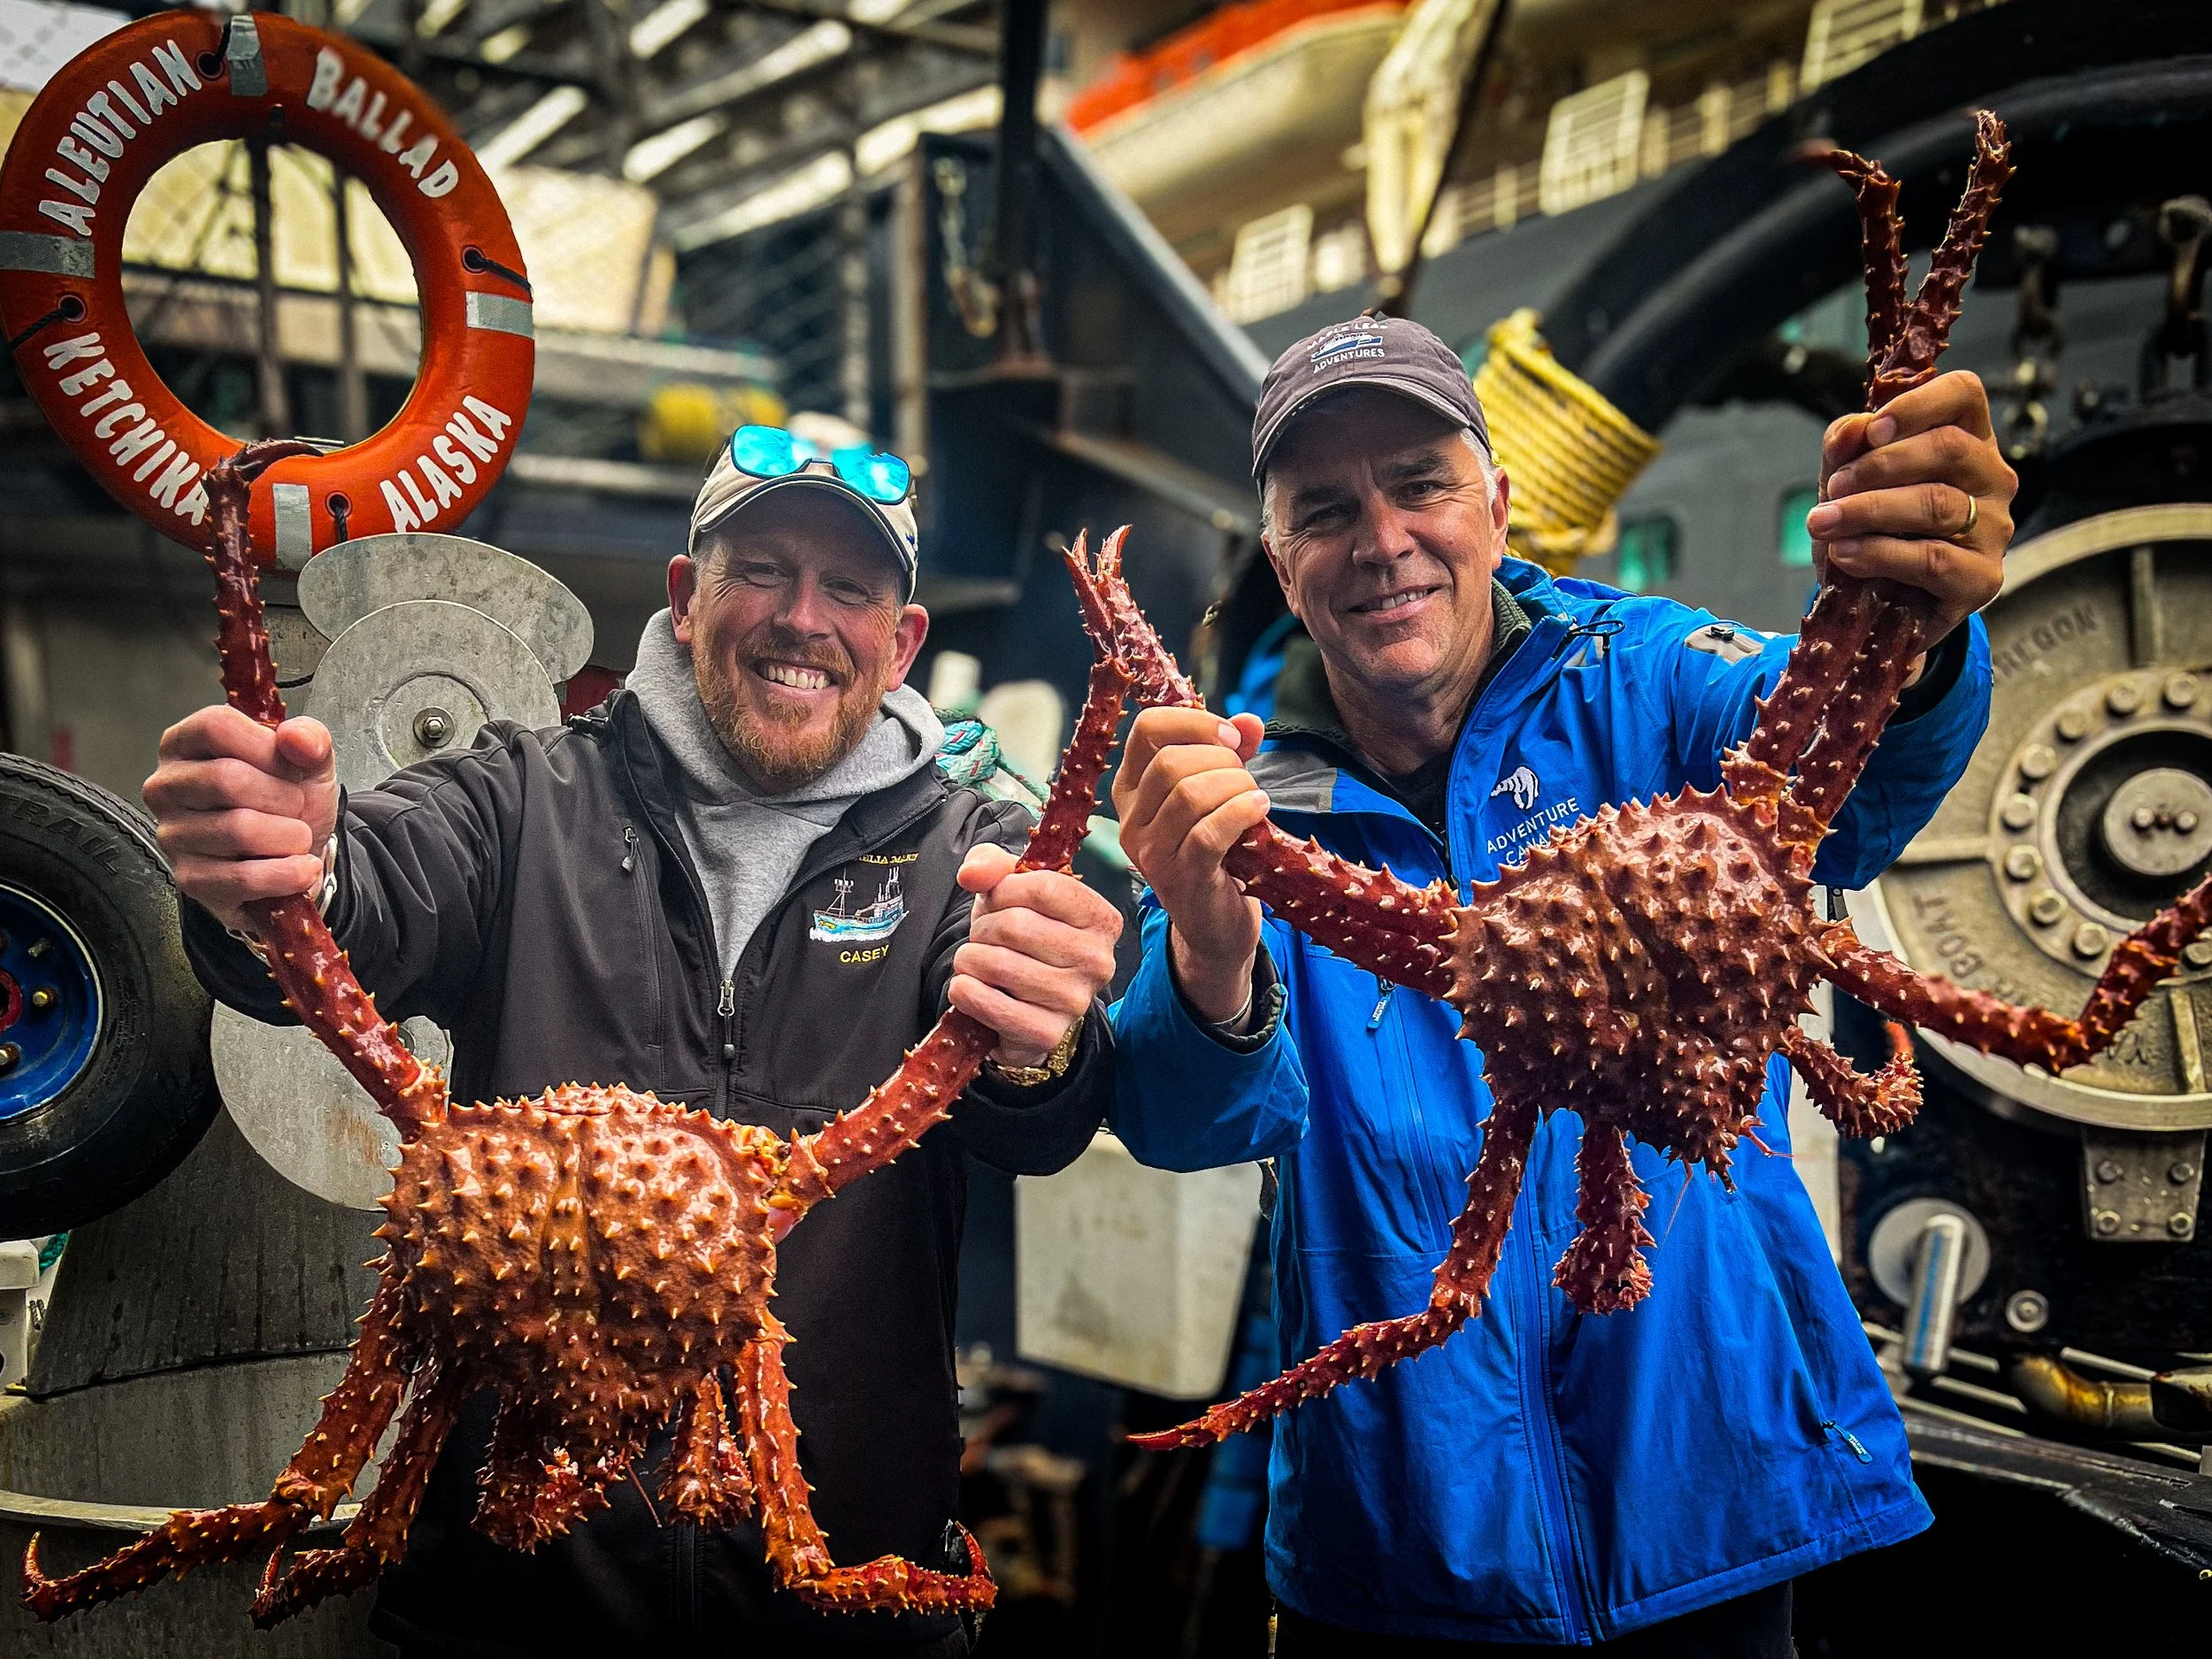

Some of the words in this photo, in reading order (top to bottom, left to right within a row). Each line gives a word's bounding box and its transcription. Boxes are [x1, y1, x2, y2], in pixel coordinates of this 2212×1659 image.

[38, 39, 203, 237] ALEUTIAN
[306, 46, 460, 199] BALLAD
[1313, 348, 1386, 374] ADVENTURES
[43, 332, 211, 527] KETCHIKA
[379, 395, 513, 534] ALASKA
[1993, 603, 2098, 680] REGON
[1486, 797, 1580, 854] ADVENTURE
[1506, 824, 1568, 865] CANA
[840, 944, 889, 964] CASEY
[1912, 894, 1985, 979] BOAT
